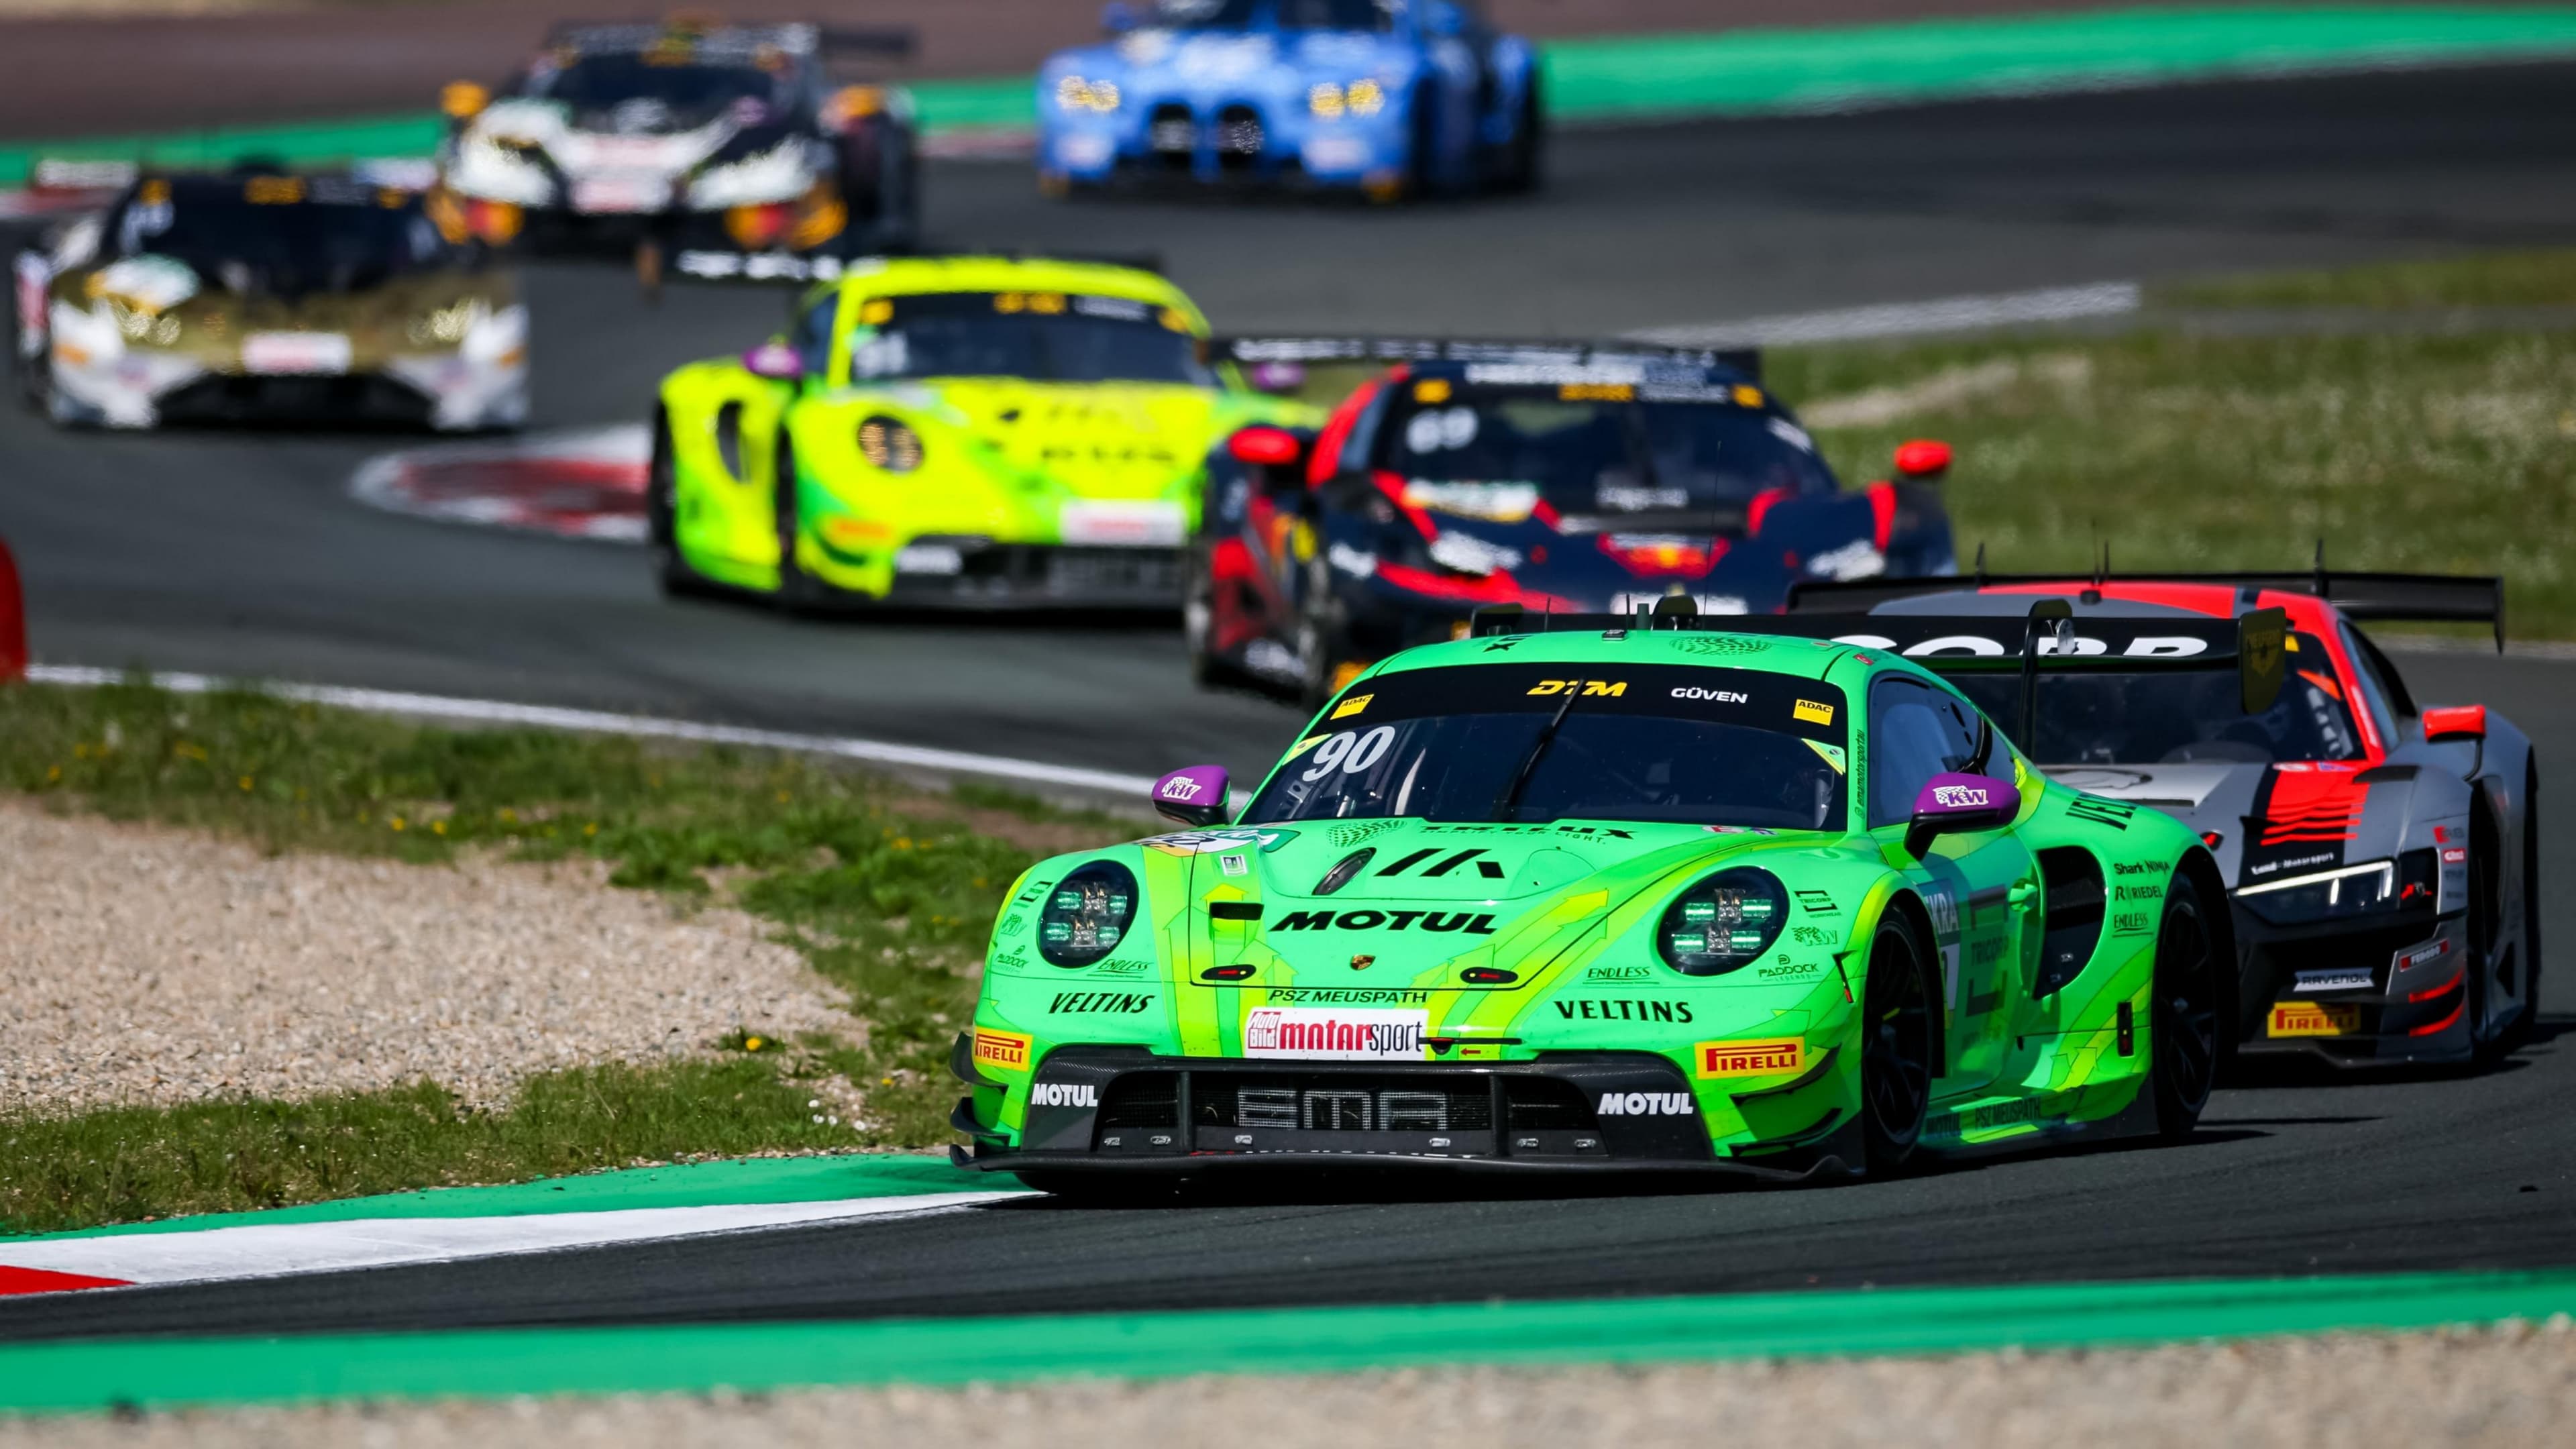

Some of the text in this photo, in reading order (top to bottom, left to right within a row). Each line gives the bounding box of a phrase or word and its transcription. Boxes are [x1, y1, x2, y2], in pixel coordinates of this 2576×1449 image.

[1527, 680, 1628, 696] DTM
[1670, 687, 1748, 704] GÜVEN
[1341, 696, 1373, 708] ADAC
[1797, 700, 1832, 713] ADAC
[1302, 725, 1395, 782] 90
[1947, 790, 1988, 806] KW
[2114, 862, 2145, 875] Shark
[2131, 886, 2163, 899] RIEDEL
[1270, 909, 1500, 935] MOTUL
[2114, 913, 2149, 929] ENDLESS
[1098, 959, 1154, 971] ENDLESS
[1587, 966, 1651, 978] ENDLESS
[1758, 963, 1820, 977] PADDOCK
[2302, 973, 2367, 985] RAVENOL
[1048, 992, 1156, 1014] VELTINS
[1268, 989, 1428, 1004] PSZ MEUSPATH
[1553, 1000, 1694, 1024] VELTINS
[975, 1033, 1024, 1064] PIRELLI
[1705, 1043, 1798, 1072] PIRELLI
[1030, 1083, 1099, 1107] MOTUL
[1597, 1092, 1694, 1116] MOTUL
